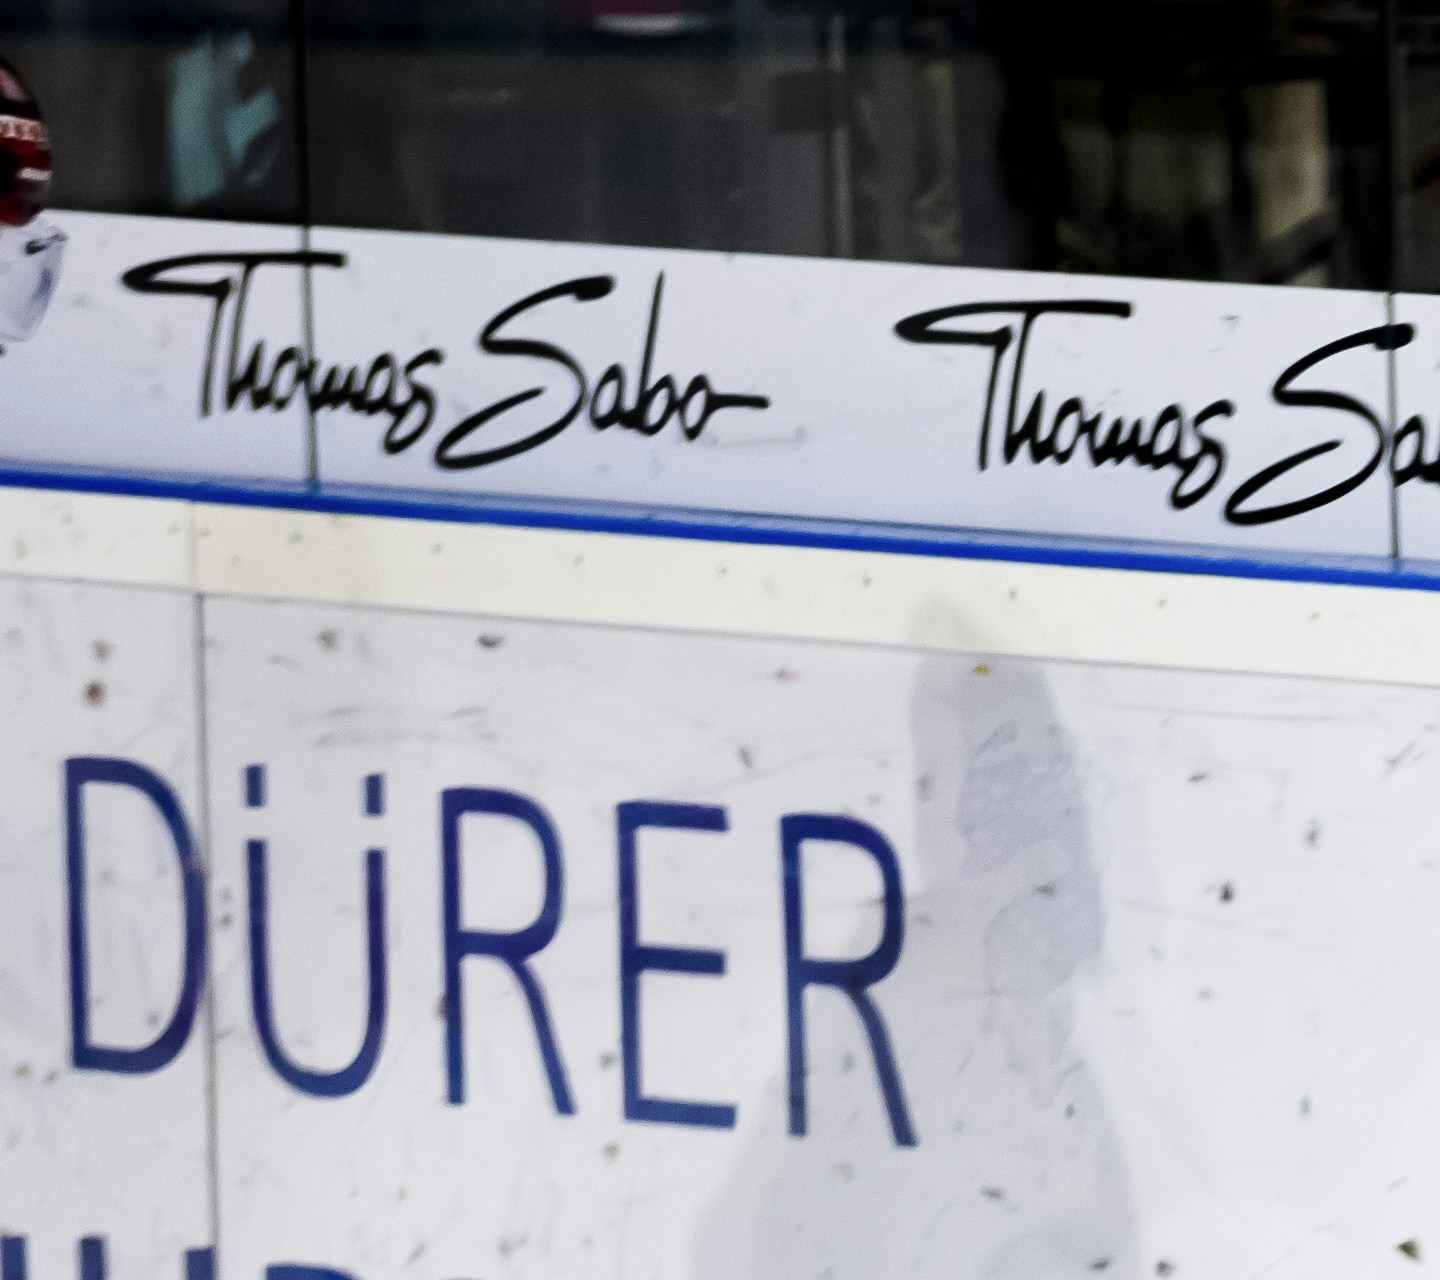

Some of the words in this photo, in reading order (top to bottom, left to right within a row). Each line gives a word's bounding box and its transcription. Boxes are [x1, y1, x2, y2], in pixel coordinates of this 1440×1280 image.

[121, 248, 446, 455] Thomas
[434, 274, 769, 471] Sabo
[894, 299, 1236, 510] Thomas
[63, 754, 918, 1149] DÜRER
